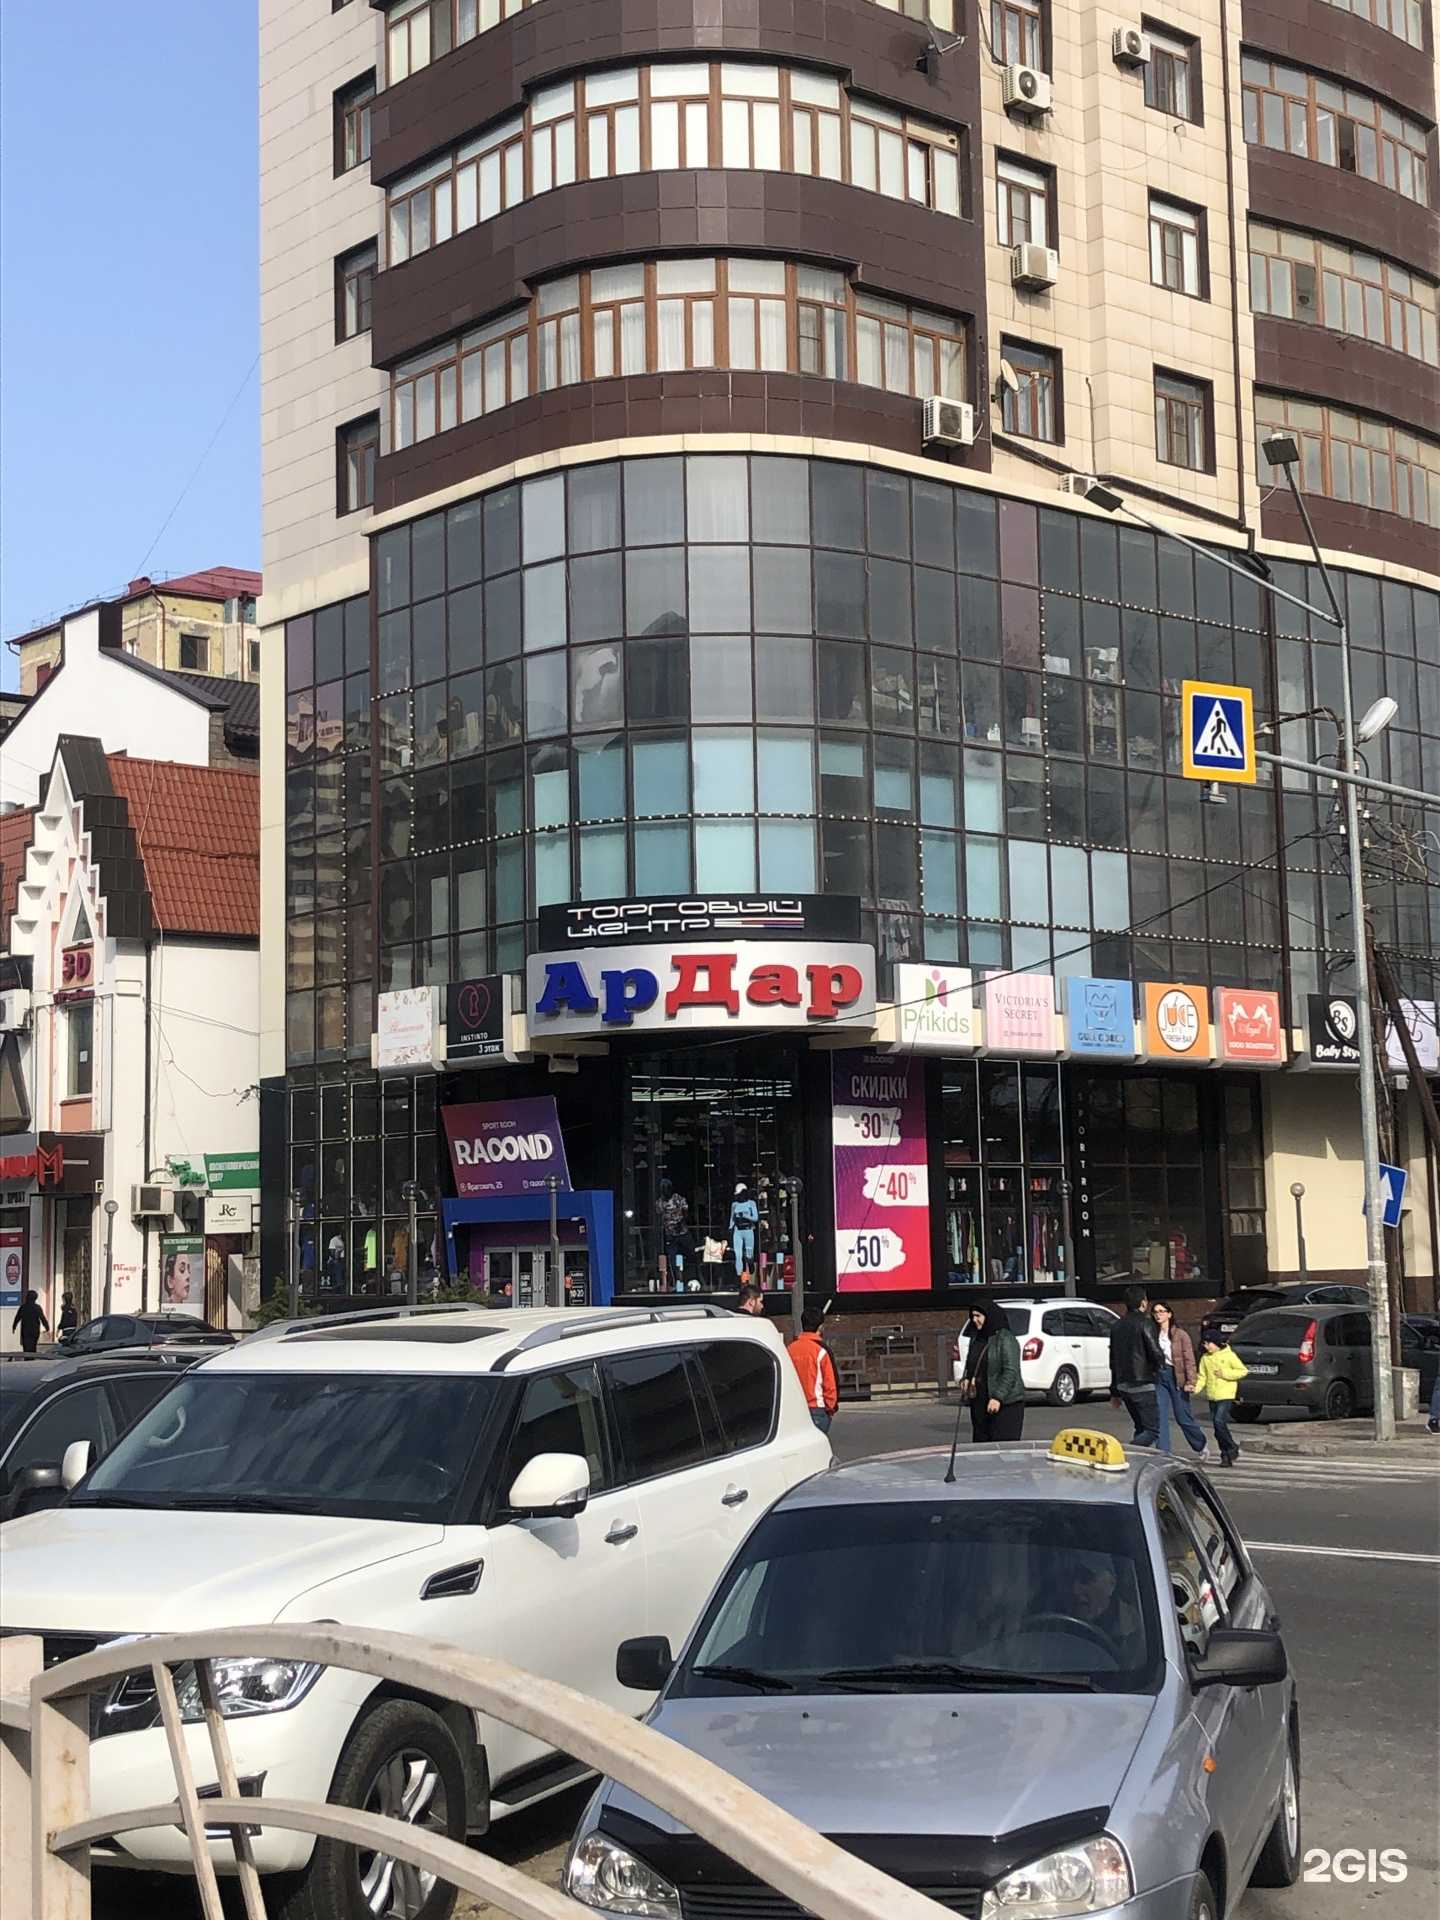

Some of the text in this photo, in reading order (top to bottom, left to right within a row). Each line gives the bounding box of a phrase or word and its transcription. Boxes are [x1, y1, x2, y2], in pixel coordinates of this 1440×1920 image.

[567, 900, 802, 920] ТОРГОВЫЙ
[535, 953, 863, 1024] АрДар
[995, 992, 1049, 1008] VICTORIA'S
[903, 1008, 970, 1034] Prikids
[1004, 1008, 1038, 1021] SECRET
[851, 1075, 908, 1101] СКИДКИ
